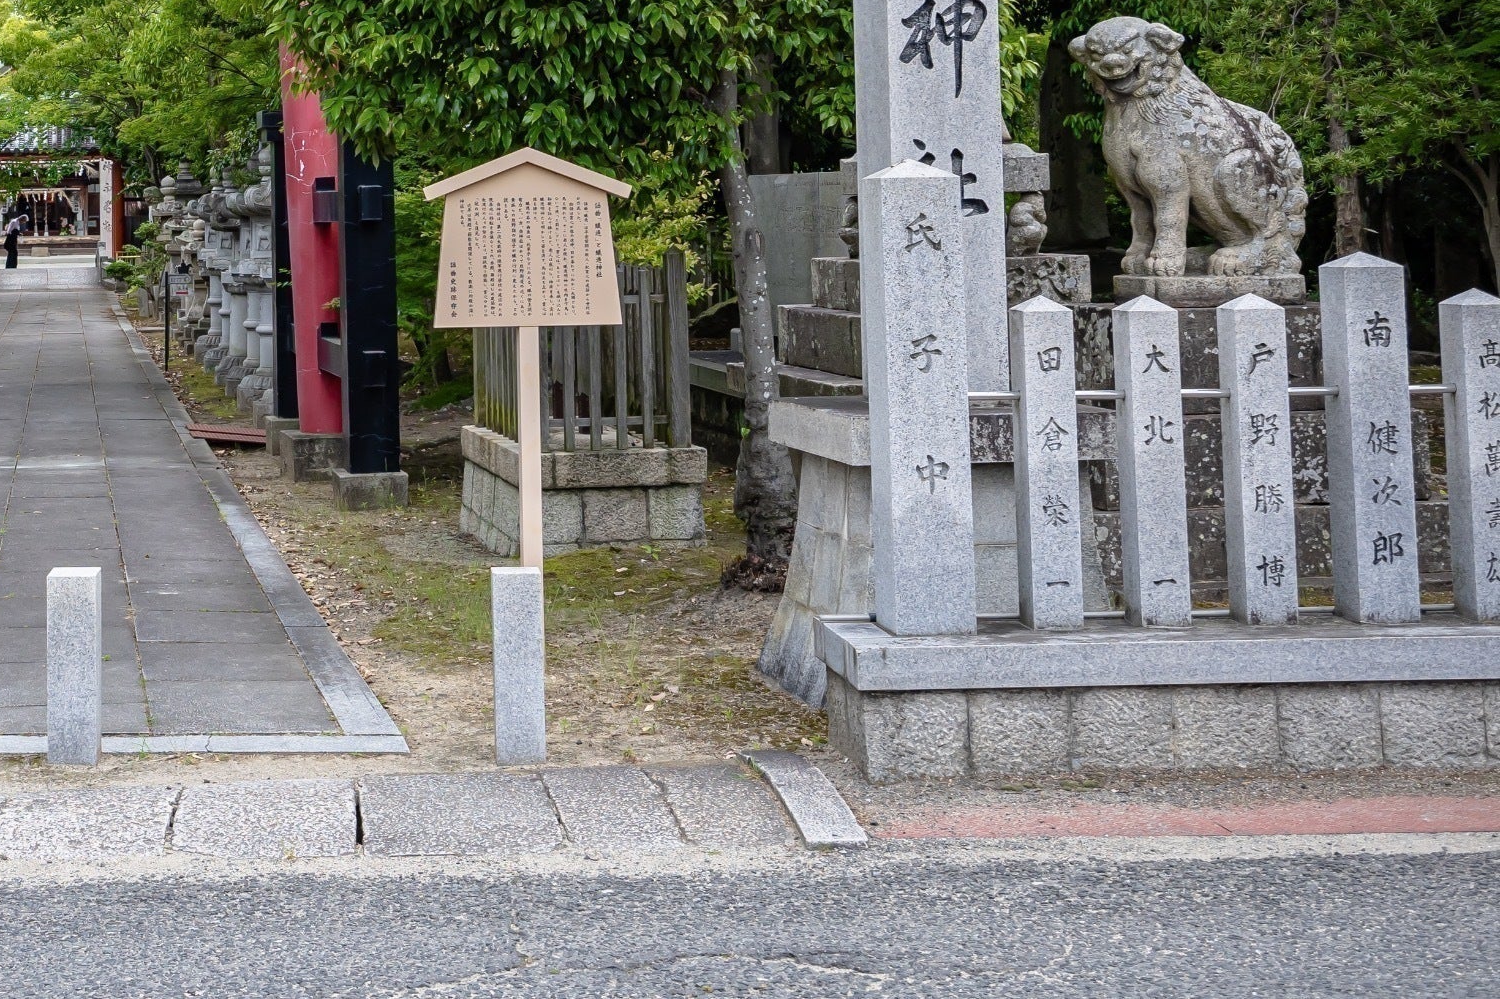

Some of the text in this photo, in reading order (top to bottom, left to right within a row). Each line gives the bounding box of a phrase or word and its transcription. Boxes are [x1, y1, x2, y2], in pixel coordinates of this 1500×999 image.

[903, 212, 950, 495] 氏子中
[1036, 346, 1070, 588] 田倉榮一
[1142, 344, 1178, 587] 大北一
[1248, 342, 1286, 588] 戸野勝博
[1363, 310, 1405, 566] 南健次郎
